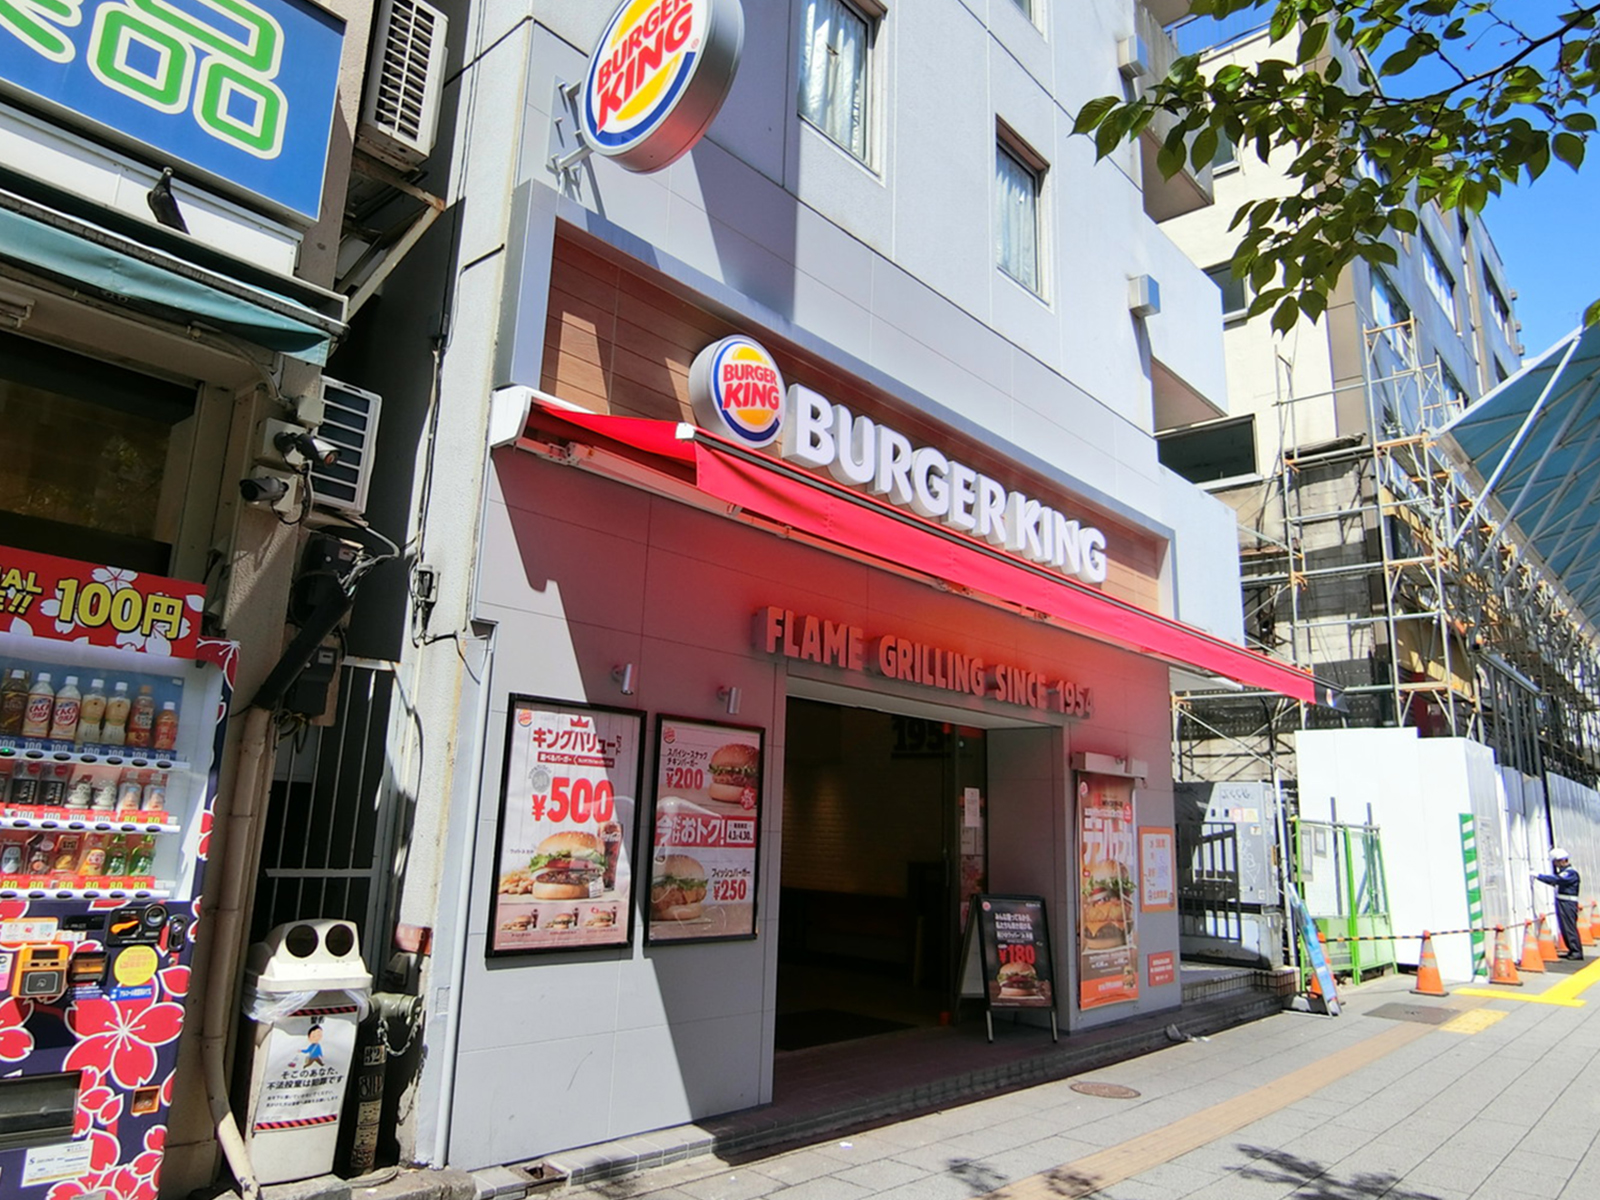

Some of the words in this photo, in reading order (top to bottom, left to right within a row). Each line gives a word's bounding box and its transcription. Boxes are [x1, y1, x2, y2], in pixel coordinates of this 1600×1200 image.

[597, 0, 690, 95] BURGE
[597, 3, 692, 134] KING
[722, 363, 778, 386] BURGER
[721, 382, 780, 411] KING
[783, 383, 1007, 545] BURGER
[1005, 490, 1107, 584] KING
[57, 578, 184, 640] 100円
[764, 605, 864, 672] FLAME
[878, 634, 986, 698] GRILLING
[995, 663, 1048, 710] SINCE
[1055, 679, 1096, 720] 1954
[532, 727, 616, 755] キングバリュー
[666, 767, 704, 790] ¥200
[531, 776, 614, 824] ¥500
[713, 878, 747, 901] ¥250
[998, 944, 1036, 965] ¥180
[281, 1067, 339, 1079] そこのあなた、
